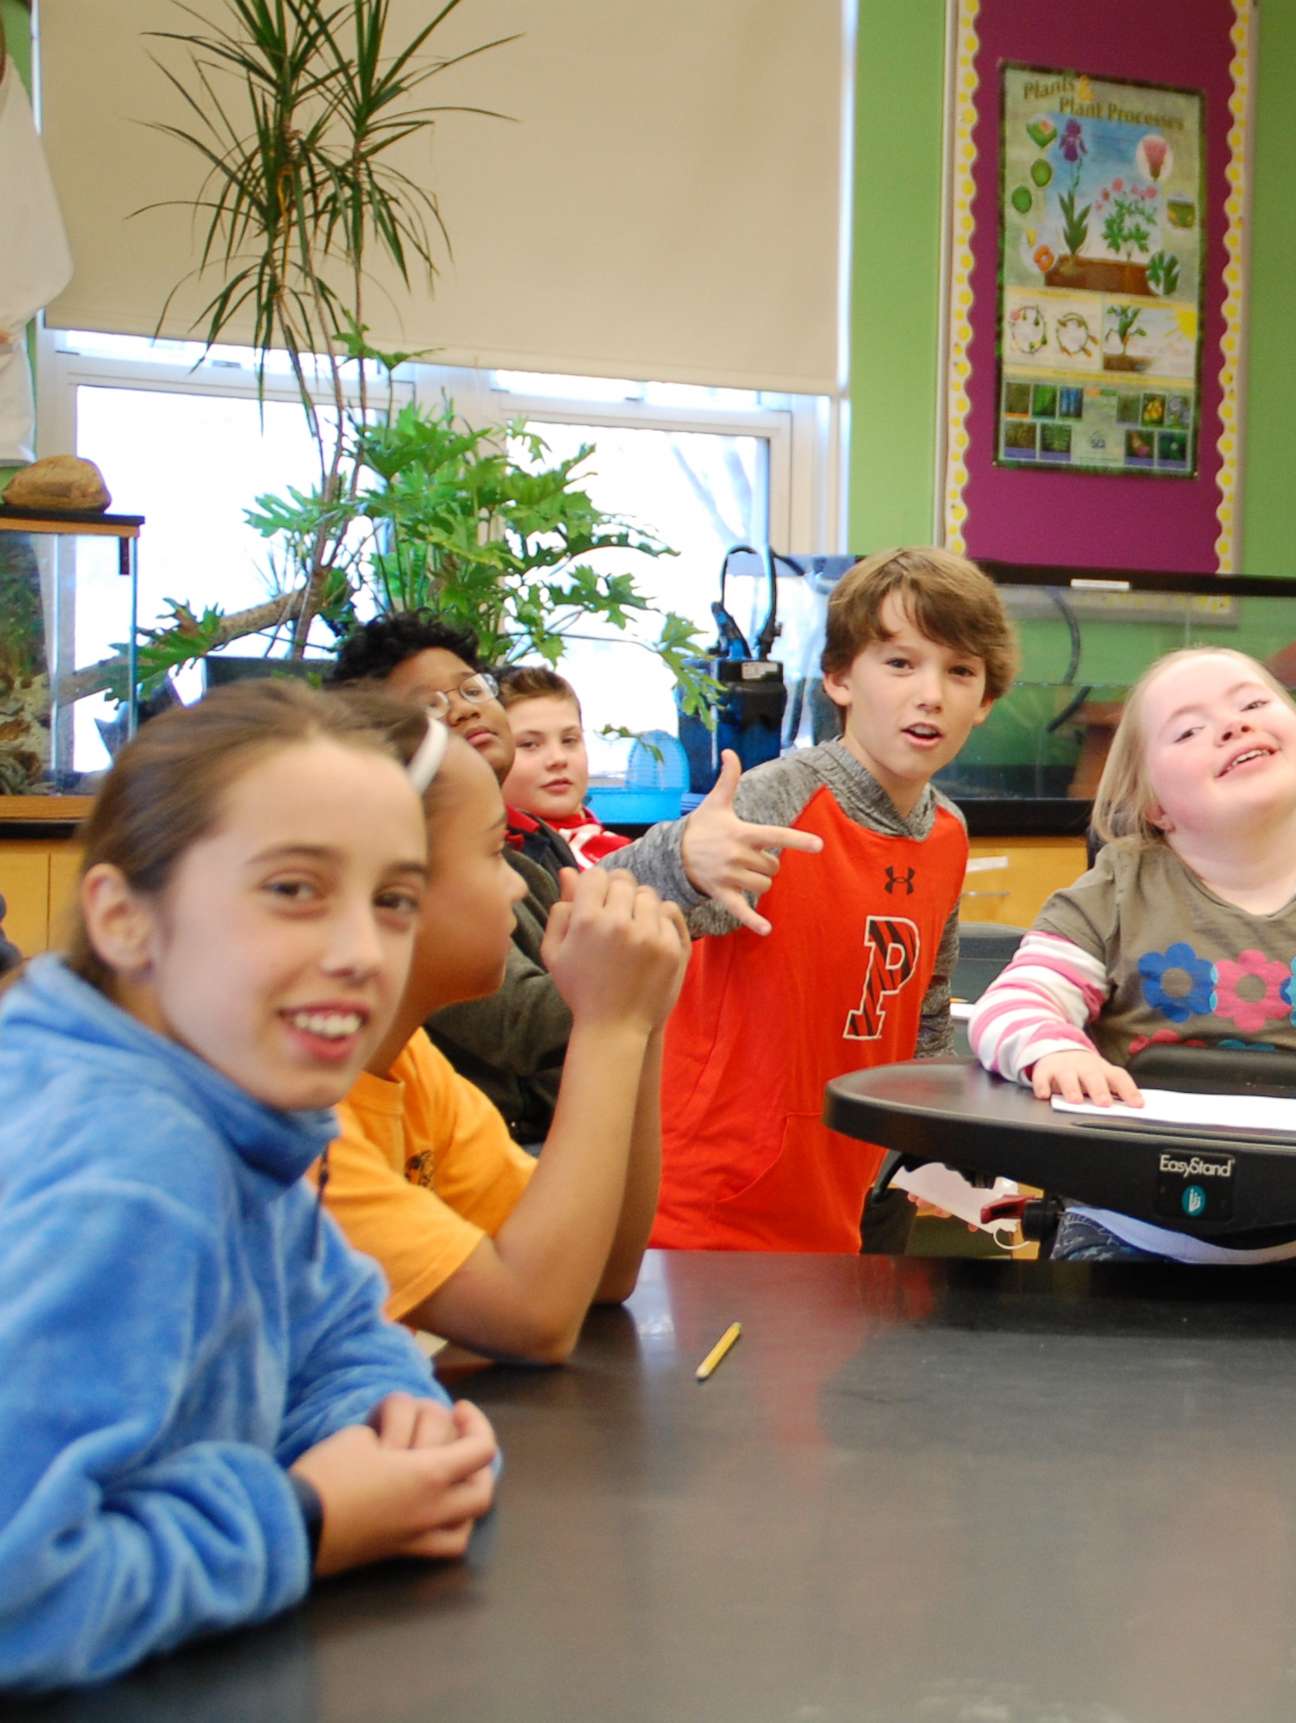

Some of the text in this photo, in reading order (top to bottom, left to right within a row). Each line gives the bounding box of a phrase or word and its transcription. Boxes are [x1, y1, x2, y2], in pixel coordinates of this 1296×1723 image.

[1023, 76, 1075, 100] Plants
[1059, 97, 1185, 130] Plant Processes
[842, 914, 921, 1041] P
[1159, 1154, 1233, 1178] EasyStand
